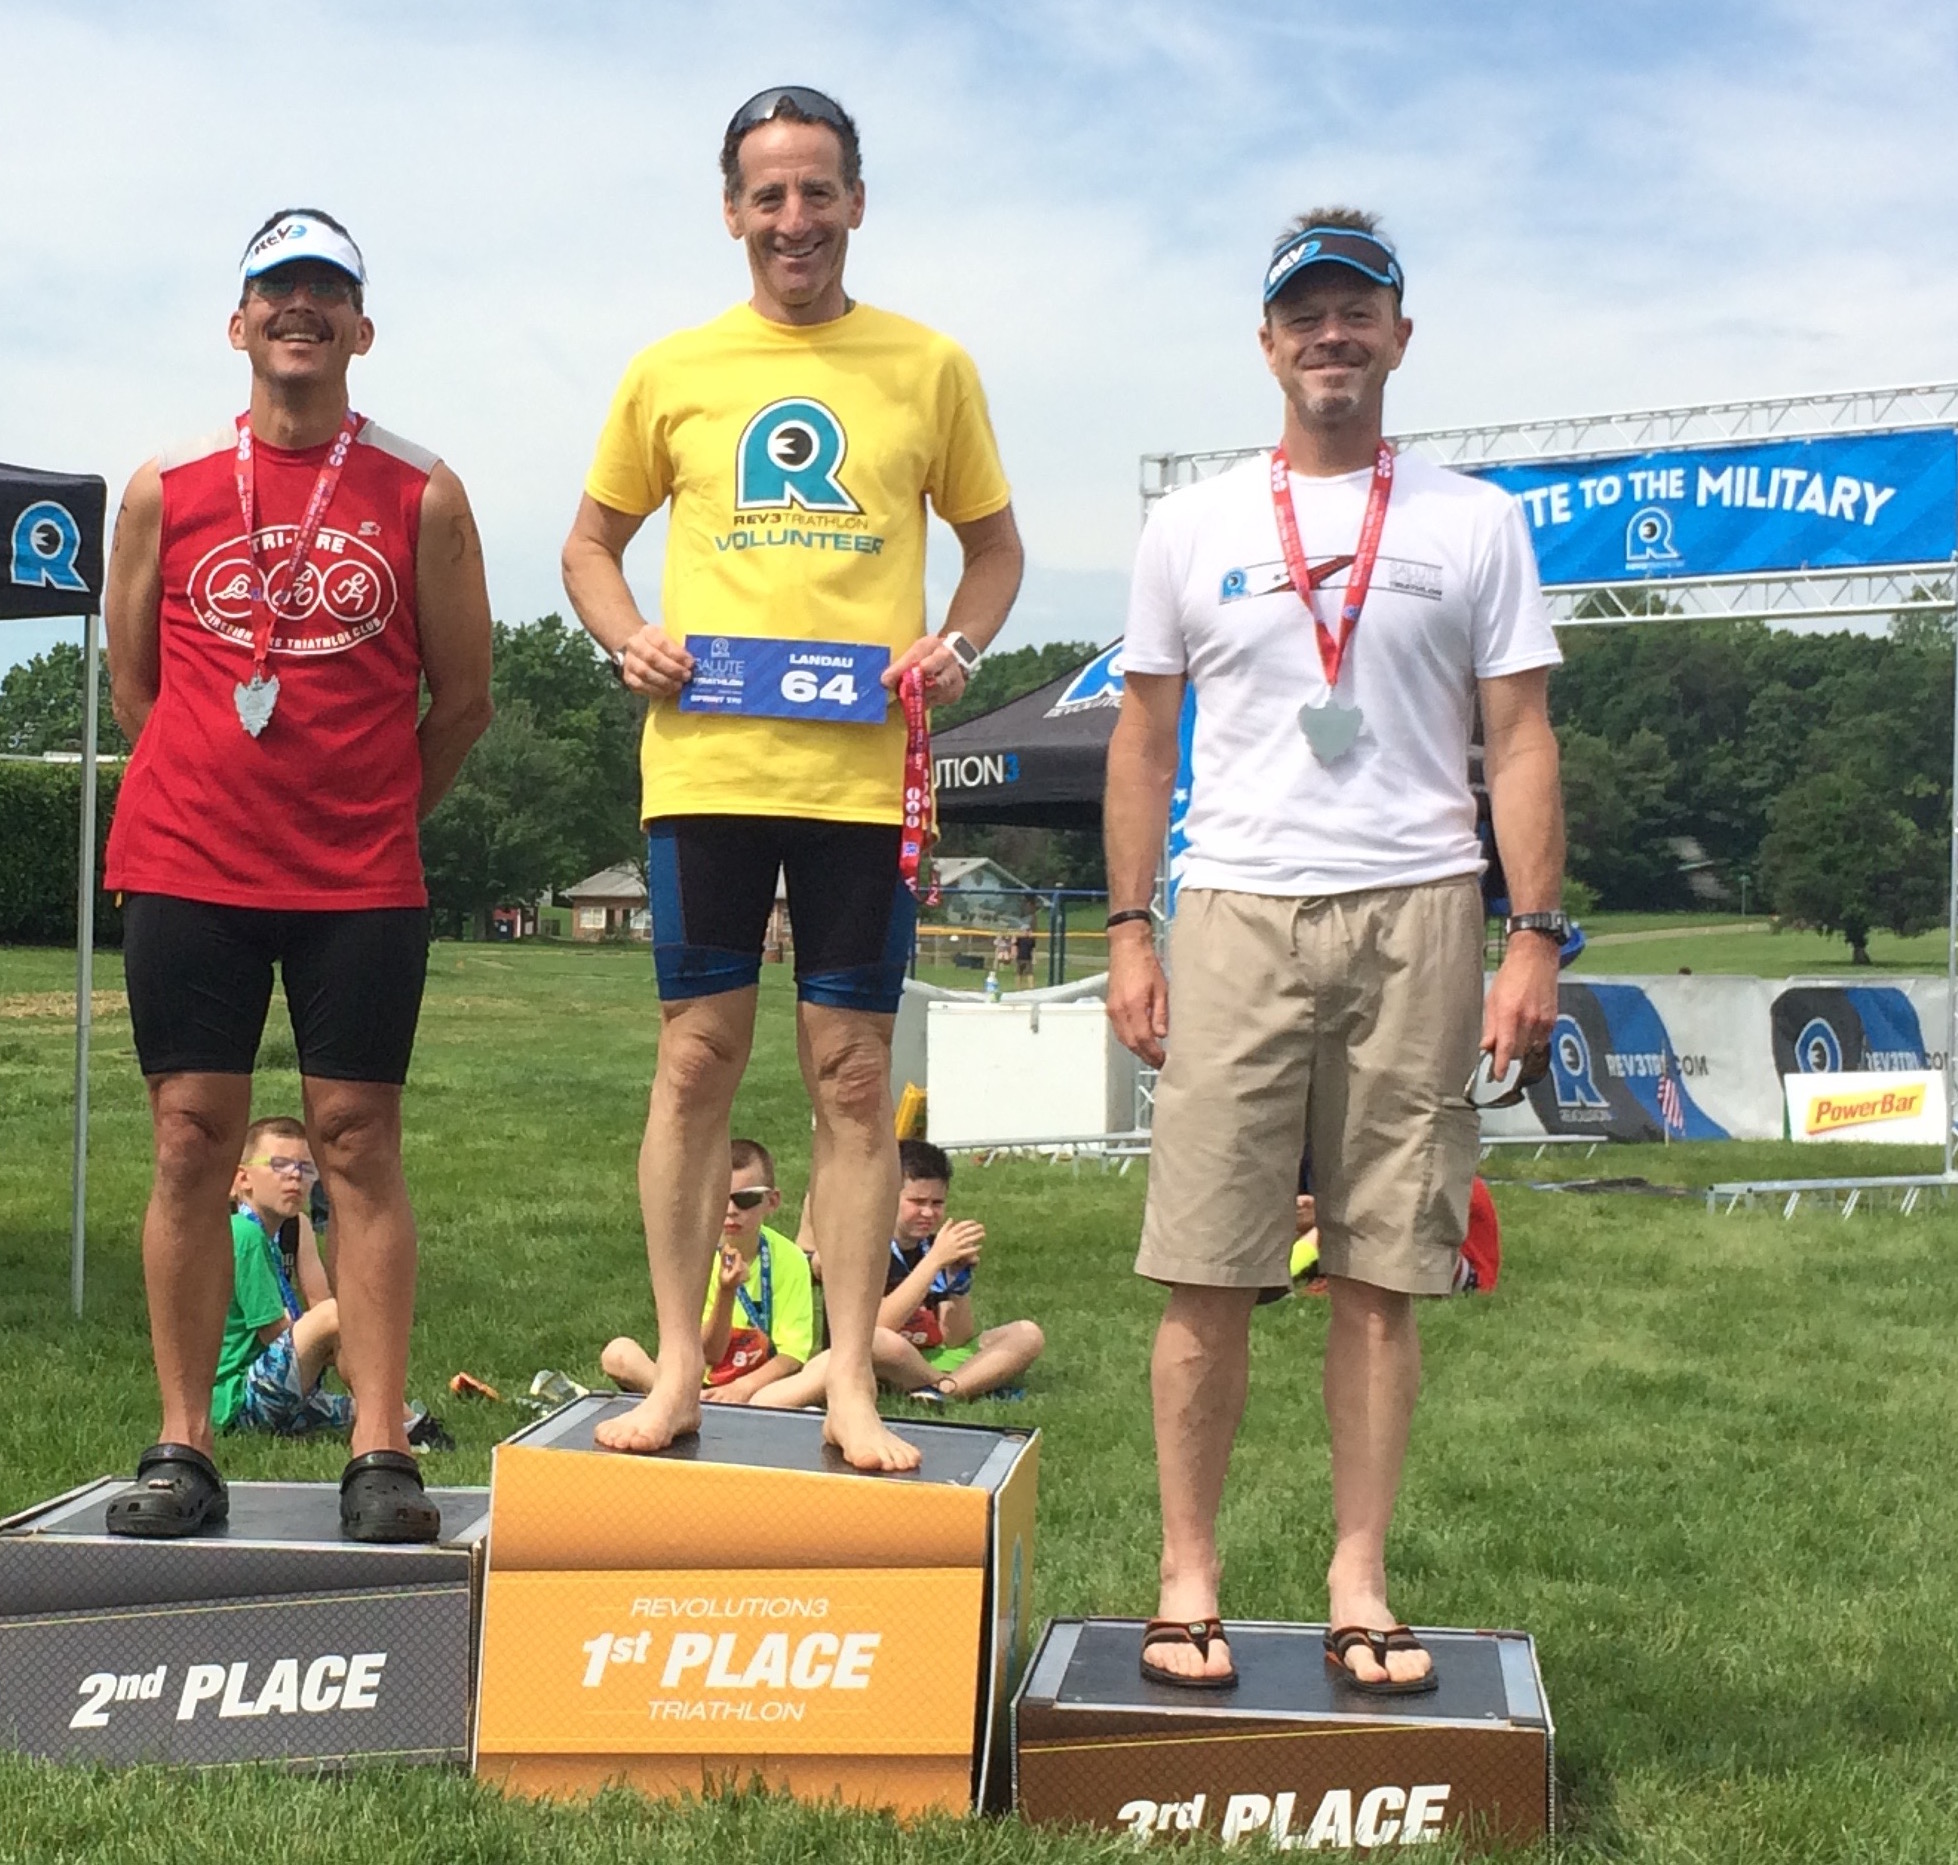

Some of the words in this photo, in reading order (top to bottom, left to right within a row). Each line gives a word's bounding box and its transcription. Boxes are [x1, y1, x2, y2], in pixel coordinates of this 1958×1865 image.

[1579, 475, 1622, 510] TO
[1627, 469, 1686, 502] THE
[1696, 465, 1897, 527] MILITARY
[733, 512, 869, 530] REV3TRIATHLON
[714, 529, 885, 555] VOLUNTEER
[352, 617, 381, 638] CLUB
[693, 657, 745, 675] SALUTE
[788, 653, 854, 668] LANDAU
[780, 670, 858, 705] 64
[1815, 1093, 1919, 1124] PowerBar
[732, 1348, 763, 1367] 87
[630, 1597, 829, 1619] REVOLUTION3
[580, 1630, 653, 1688] 1st
[660, 1632, 882, 1690] PLACE
[69, 1665, 168, 1730] 2nd
[176, 1652, 388, 1721] PLACE
[647, 1700, 806, 1723] TRIATHLON
[1116, 1793, 1207, 1843] 3rd
[1221, 1784, 1452, 1851] PLACE
